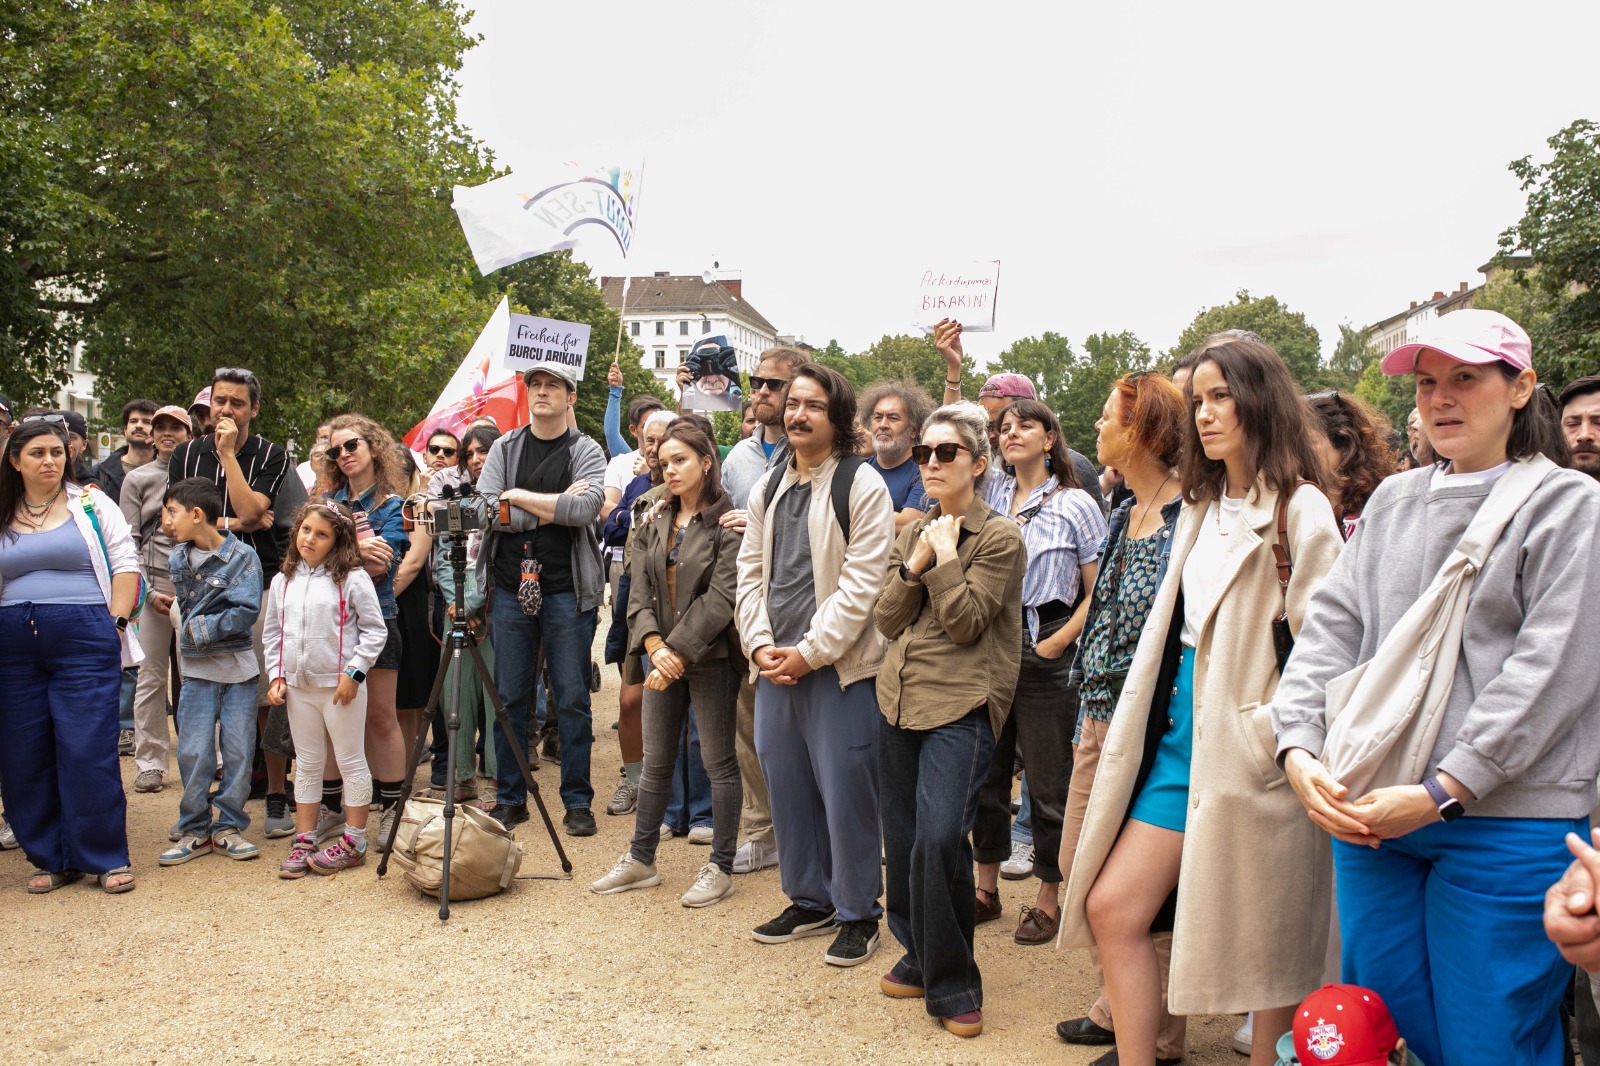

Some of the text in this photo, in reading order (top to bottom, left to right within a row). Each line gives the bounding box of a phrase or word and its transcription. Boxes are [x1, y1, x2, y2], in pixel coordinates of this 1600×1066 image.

[517, 324, 581, 352] Freiheit für
[509, 343, 583, 367] BURCU ARIKAN
